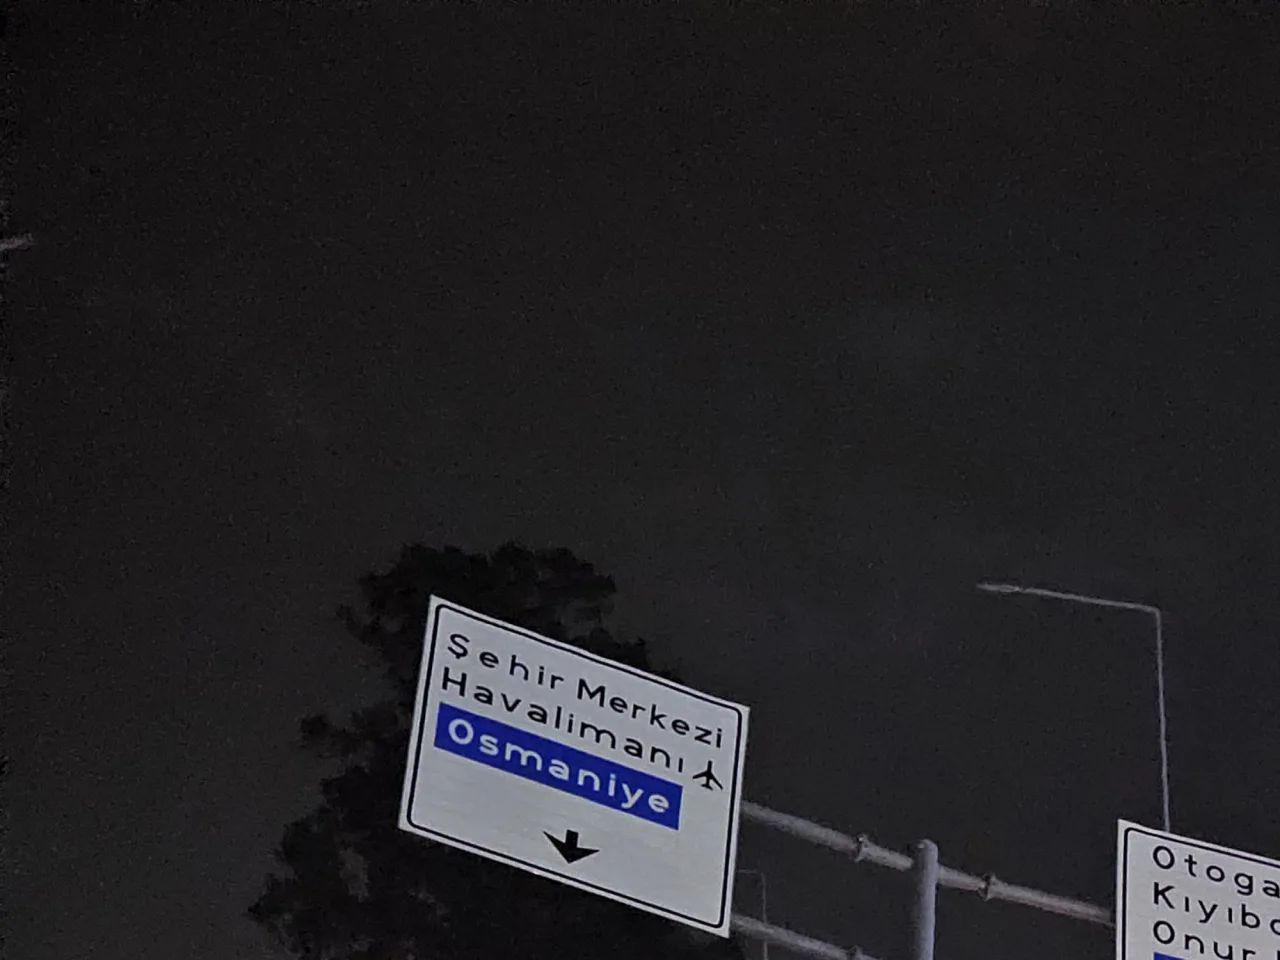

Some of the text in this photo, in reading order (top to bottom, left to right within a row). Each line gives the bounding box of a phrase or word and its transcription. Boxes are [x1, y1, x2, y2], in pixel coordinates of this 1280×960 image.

[441, 667, 685, 773] Havalimanı
[447, 633, 724, 749] Şehir Merkezi
[448, 718, 670, 814] Osmaniye
